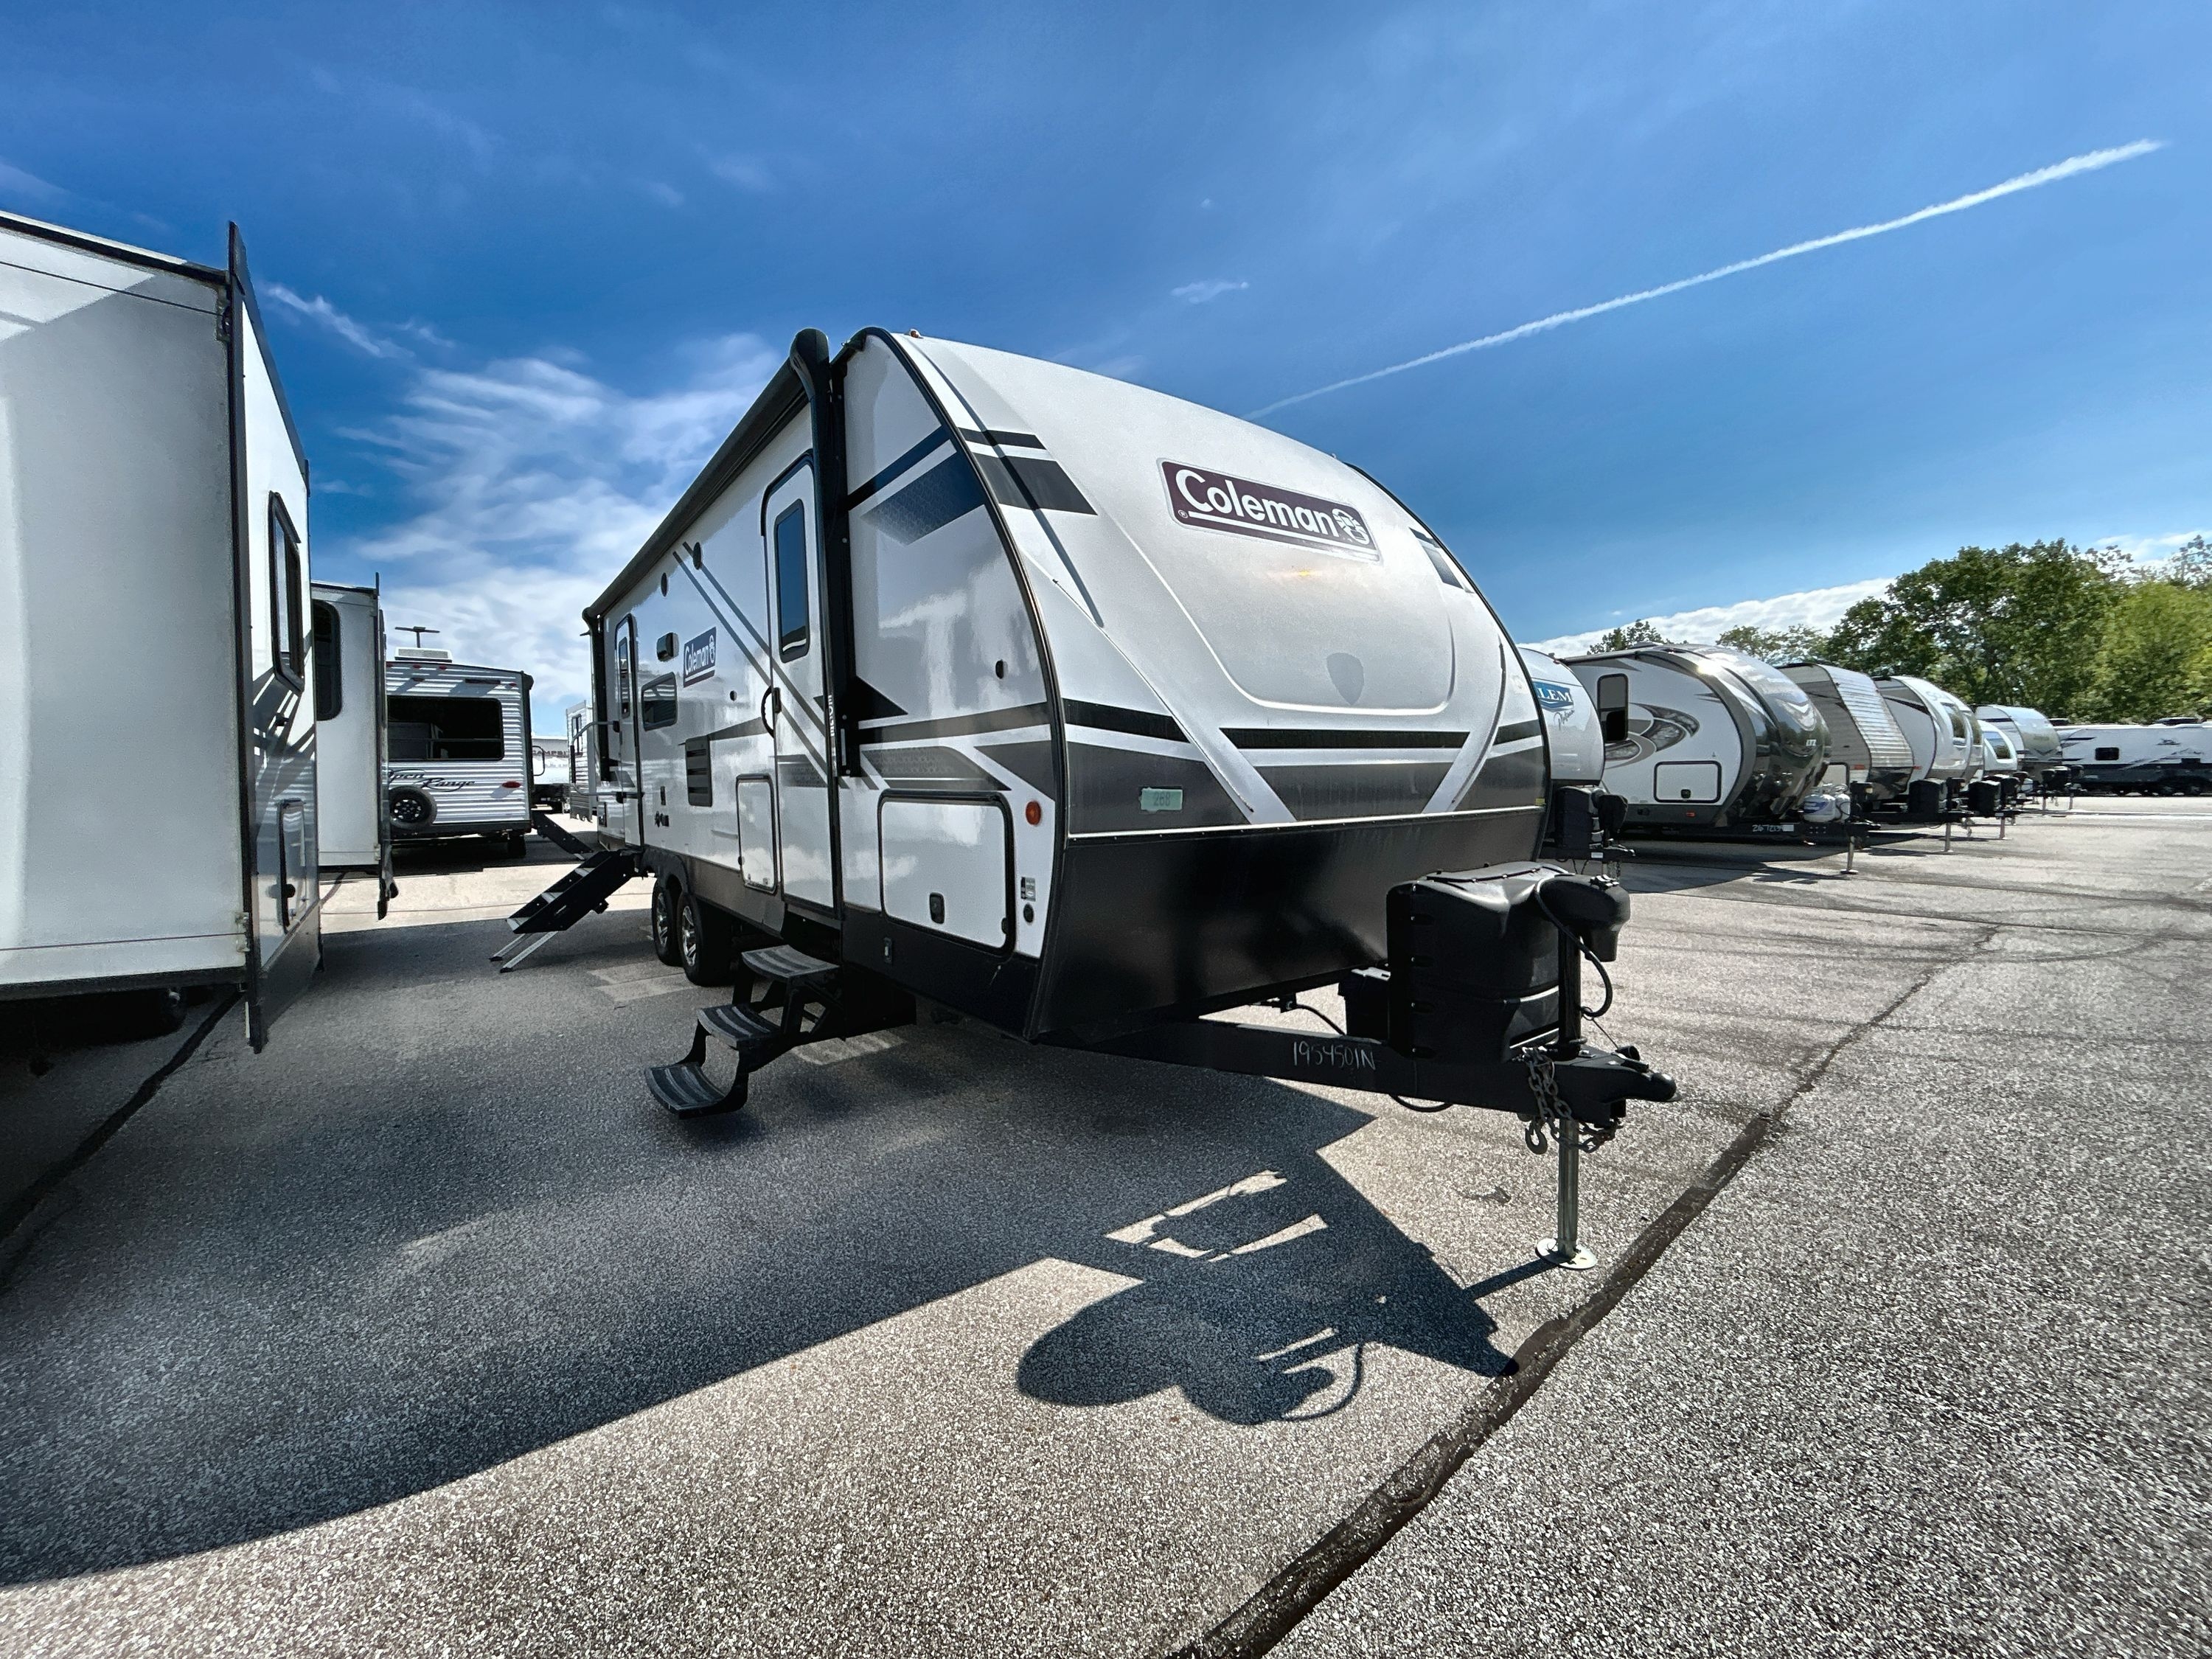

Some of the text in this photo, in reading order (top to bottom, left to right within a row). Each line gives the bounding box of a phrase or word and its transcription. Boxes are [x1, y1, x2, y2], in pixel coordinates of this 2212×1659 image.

[1175, 468, 1339, 538] Coleman
[684, 643, 709, 675] Coleman
[414, 777, 476, 792] Range
